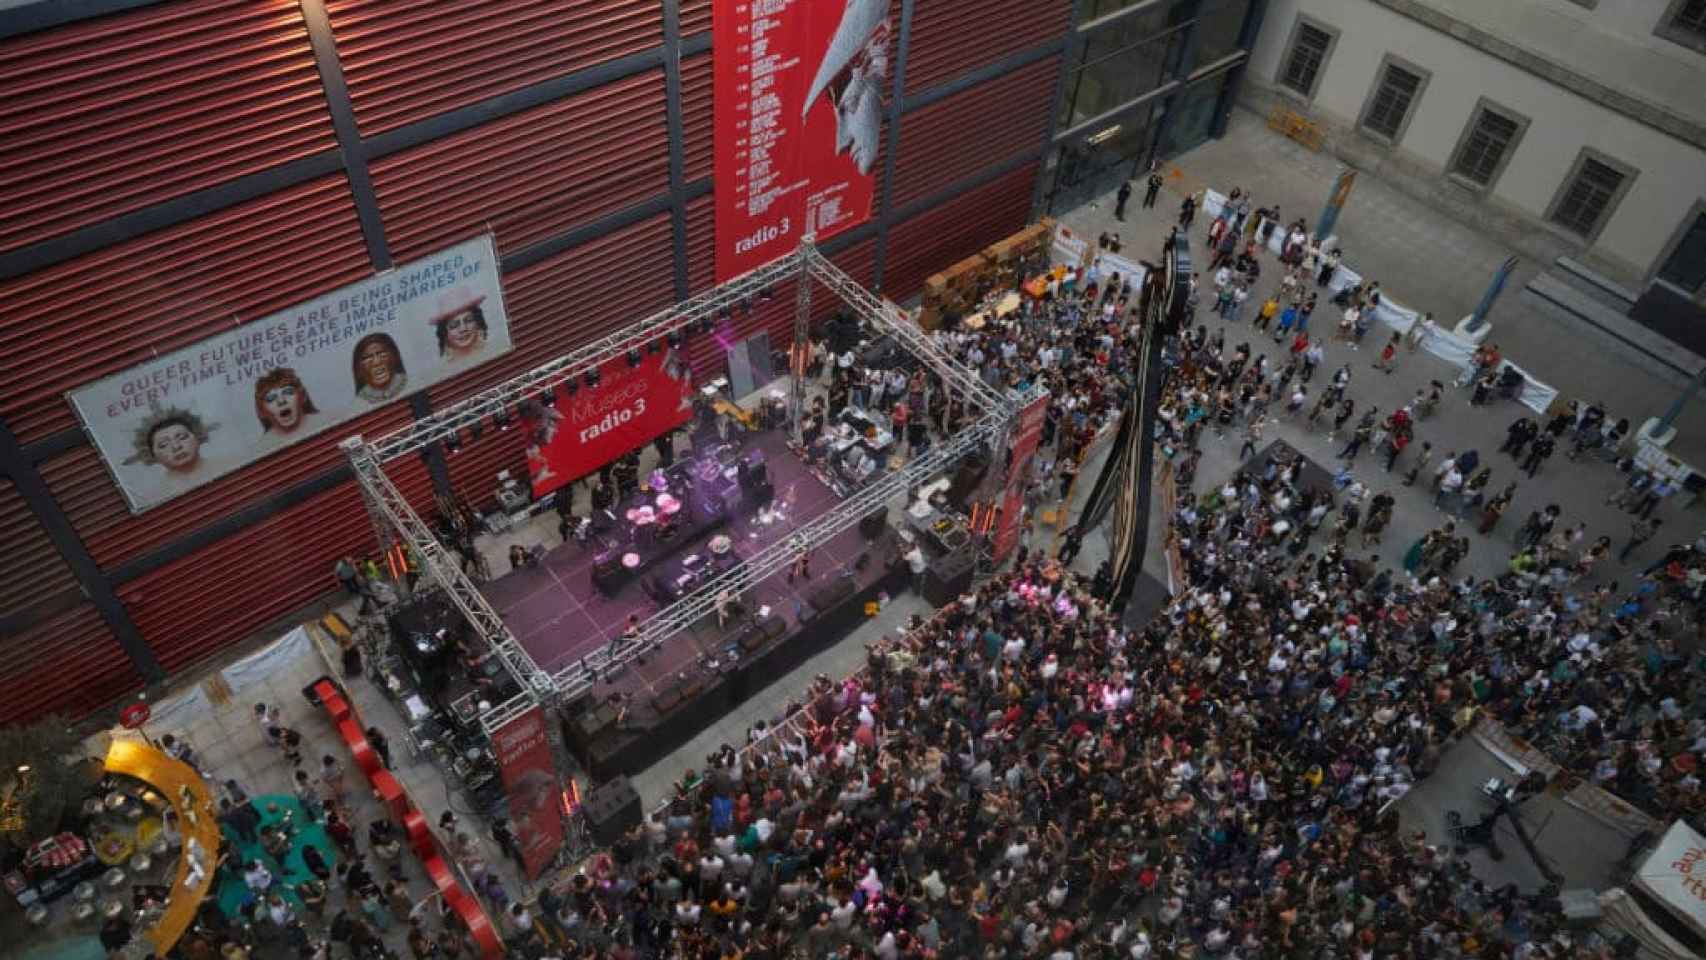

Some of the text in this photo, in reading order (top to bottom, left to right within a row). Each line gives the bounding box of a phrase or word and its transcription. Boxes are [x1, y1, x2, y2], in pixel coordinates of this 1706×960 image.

[735, 225, 779, 254] radio
[780, 216, 790, 235] 3
[106, 260, 481, 418] EVERY TIME WE CREATE IMAGINARIES OF
[121, 255, 465, 396] QUEER FUTURES ARE BEING SHAPED
[226, 309, 398, 386] LIVING OTHERWISE
[578, 398, 647, 444] radio 3
